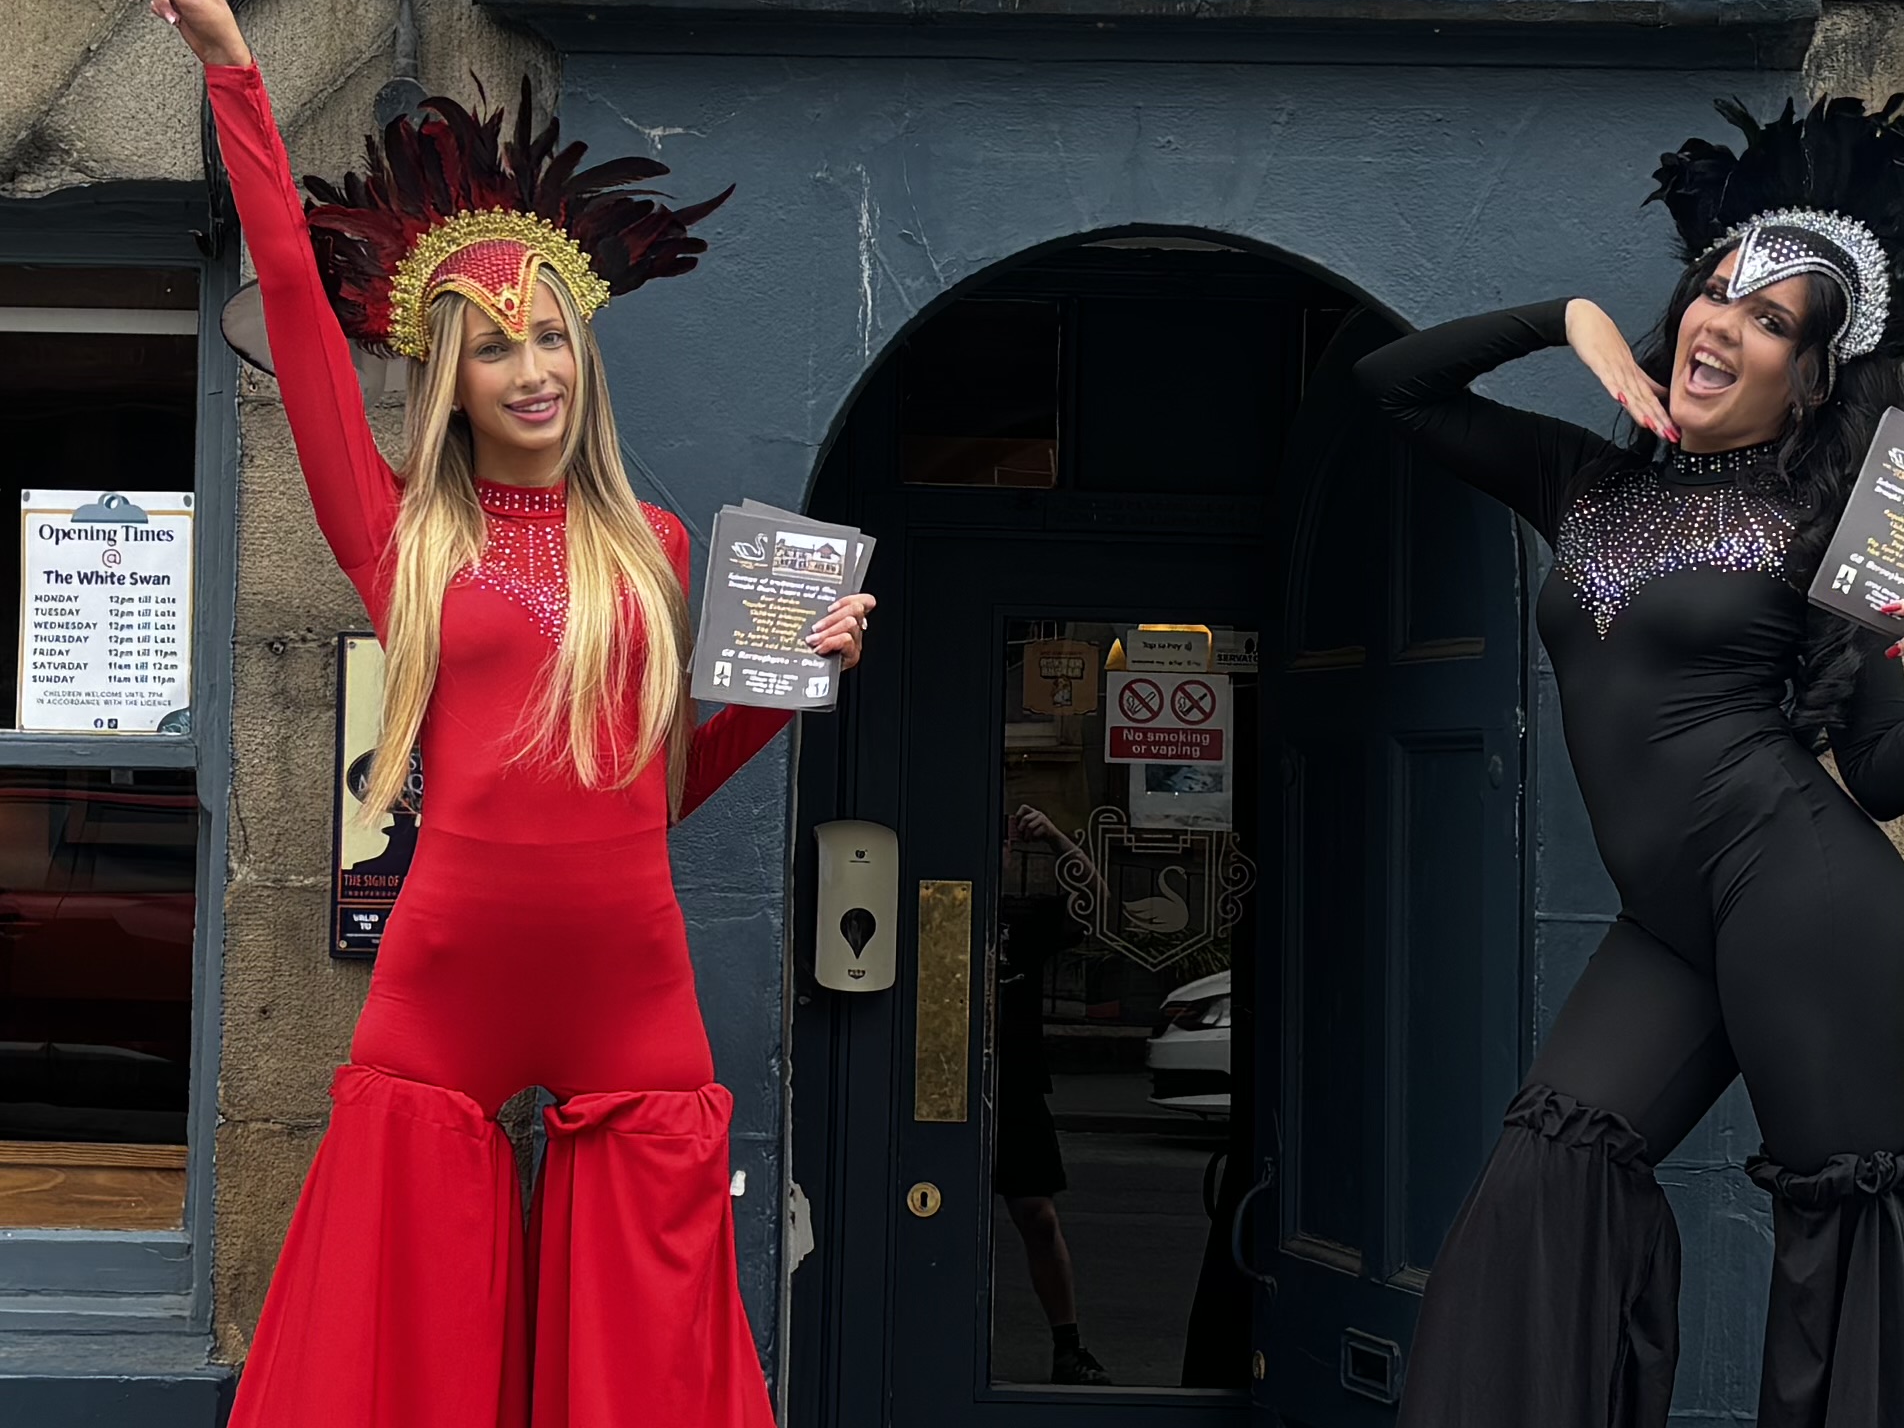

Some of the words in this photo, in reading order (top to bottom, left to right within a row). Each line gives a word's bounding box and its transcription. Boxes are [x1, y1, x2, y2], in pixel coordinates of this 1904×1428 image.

[38, 524, 117, 547] Opening
[120, 525, 174, 542] Times
[101, 548, 122, 568] @
[43, 570, 73, 585] The
[77, 570, 126, 586] White
[129, 572, 171, 586] Swan
[34, 594, 80, 603] MONDAY
[108, 595, 134, 605] 12pm
[138, 595, 152, 604] till
[155, 596, 176, 604] Late
[34, 608, 81, 617] TUESDAY
[108, 609, 134, 619] 12pm
[138, 609, 151, 618] till
[155, 609, 176, 618] Late
[33, 621, 98, 630] WEDNESDAY
[33, 635, 89, 643] THURSDAY
[32, 648, 71, 657] FRIDAY
[32, 662, 89, 670] SATURDAY
[32, 675, 75, 684] SUNDAY
[1123, 729, 1143, 742] No
[1147, 729, 1210, 746] smoking
[1132, 744, 1147, 754] or
[1151, 742, 1201, 758] vaping
[344, 874, 362, 887] THE
[364, 875, 386, 887] SIGN
[388, 875, 400, 887] OF
